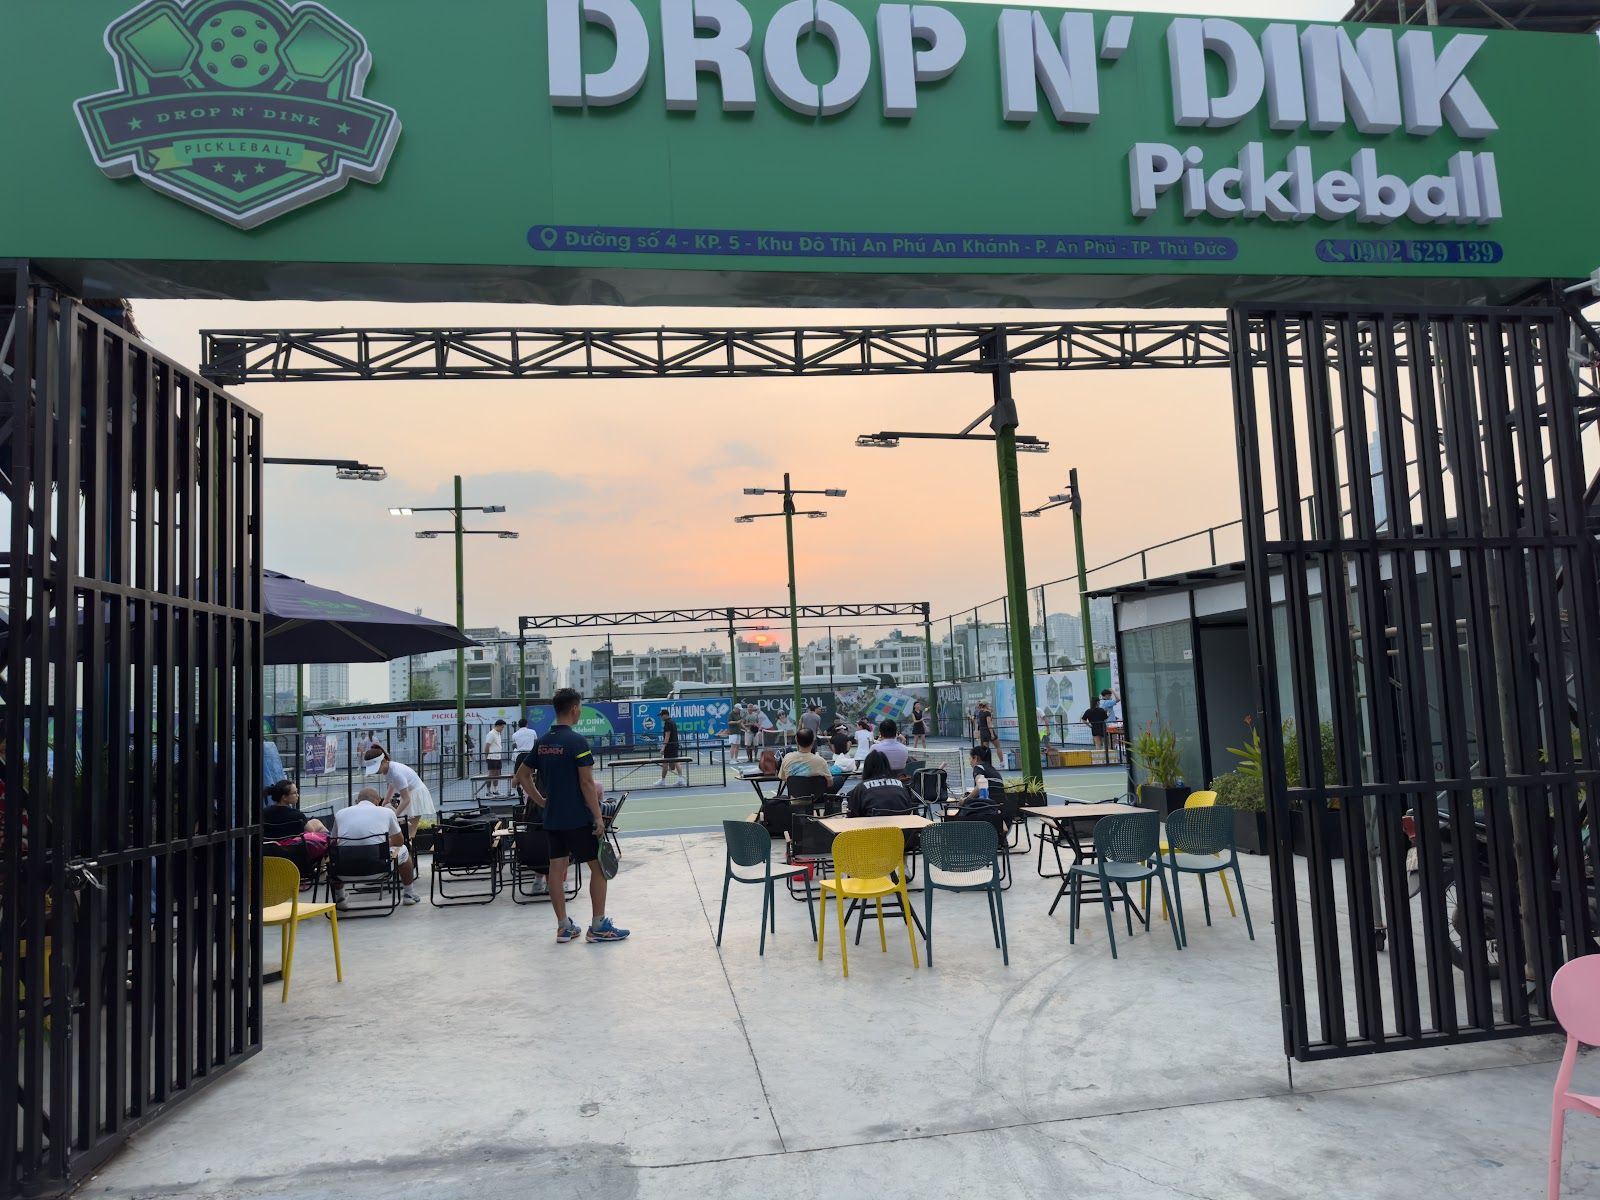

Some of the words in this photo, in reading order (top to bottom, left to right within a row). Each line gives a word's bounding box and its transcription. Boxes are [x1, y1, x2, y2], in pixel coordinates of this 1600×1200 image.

[547, 0, 967, 118] DROP
[999, 9, 1133, 124] N'
[1167, 17, 1498, 139] DINK
[157, 107, 221, 123] DROP
[231, 106, 253, 117] N'
[263, 109, 320, 127] DINK
[184, 142, 292, 157] PICKLEBALL
[1128, 141, 1502, 224] Pickleball
[565, 226, 631, 251] Đường
[637, 230, 661, 248] số
[665, 234, 677, 248] 4
[695, 235, 722, 250] KP.
[729, 235, 740, 250] 5
[757, 236, 793, 251] Khu
[799, 236, 825, 251] Đô
[830, 237, 857, 256] Thị
[862, 238, 887, 252] An
[932, 239, 956, 253] An
[962, 238, 1020, 254] Khánh
[1036, 239, 1049, 254] P.
[1055, 240, 1079, 254] An
[1193, 240, 1227, 256] Đức
[1351, 242, 1402, 262] 0902
[1411, 242, 1448, 262] 629
[1457, 242, 1494, 262] 139
[757, 697, 827, 711] PICKLBALL
[431, 712, 480, 720] PICKLEALL
